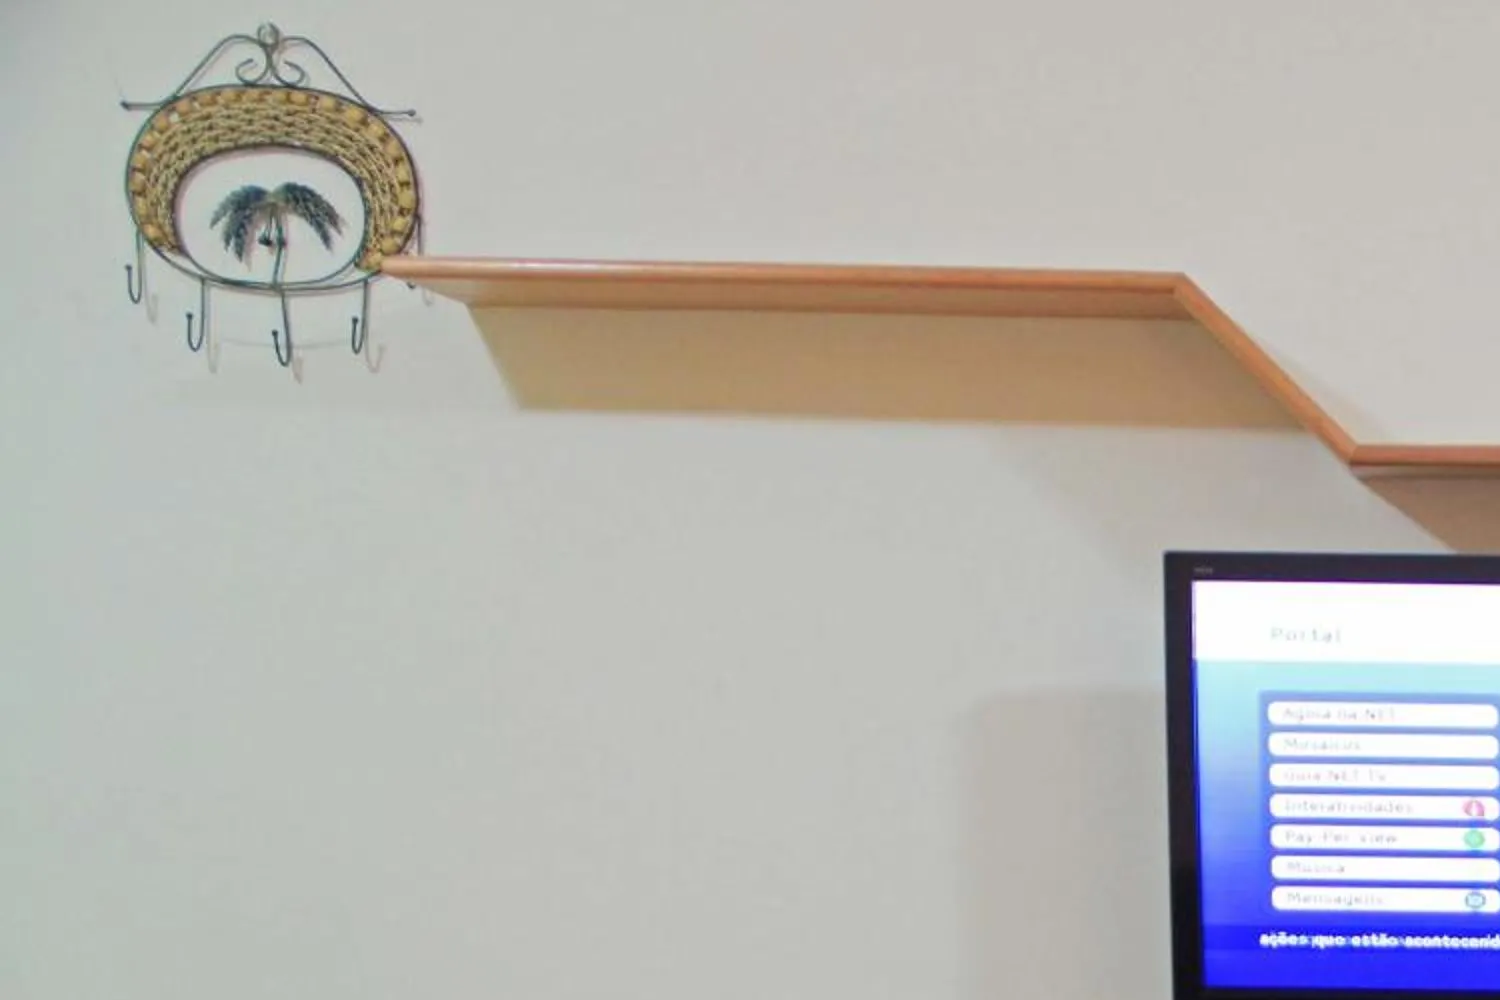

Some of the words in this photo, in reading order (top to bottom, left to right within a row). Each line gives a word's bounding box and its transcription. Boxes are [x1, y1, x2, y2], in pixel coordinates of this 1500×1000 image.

[1270, 626, 1343, 643] Portal
[1327, 768, 1359, 783] NET
[1284, 830, 1313, 845] Pay
[1312, 935, 1346, 949] que
[1351, 933, 1398, 948] estão
